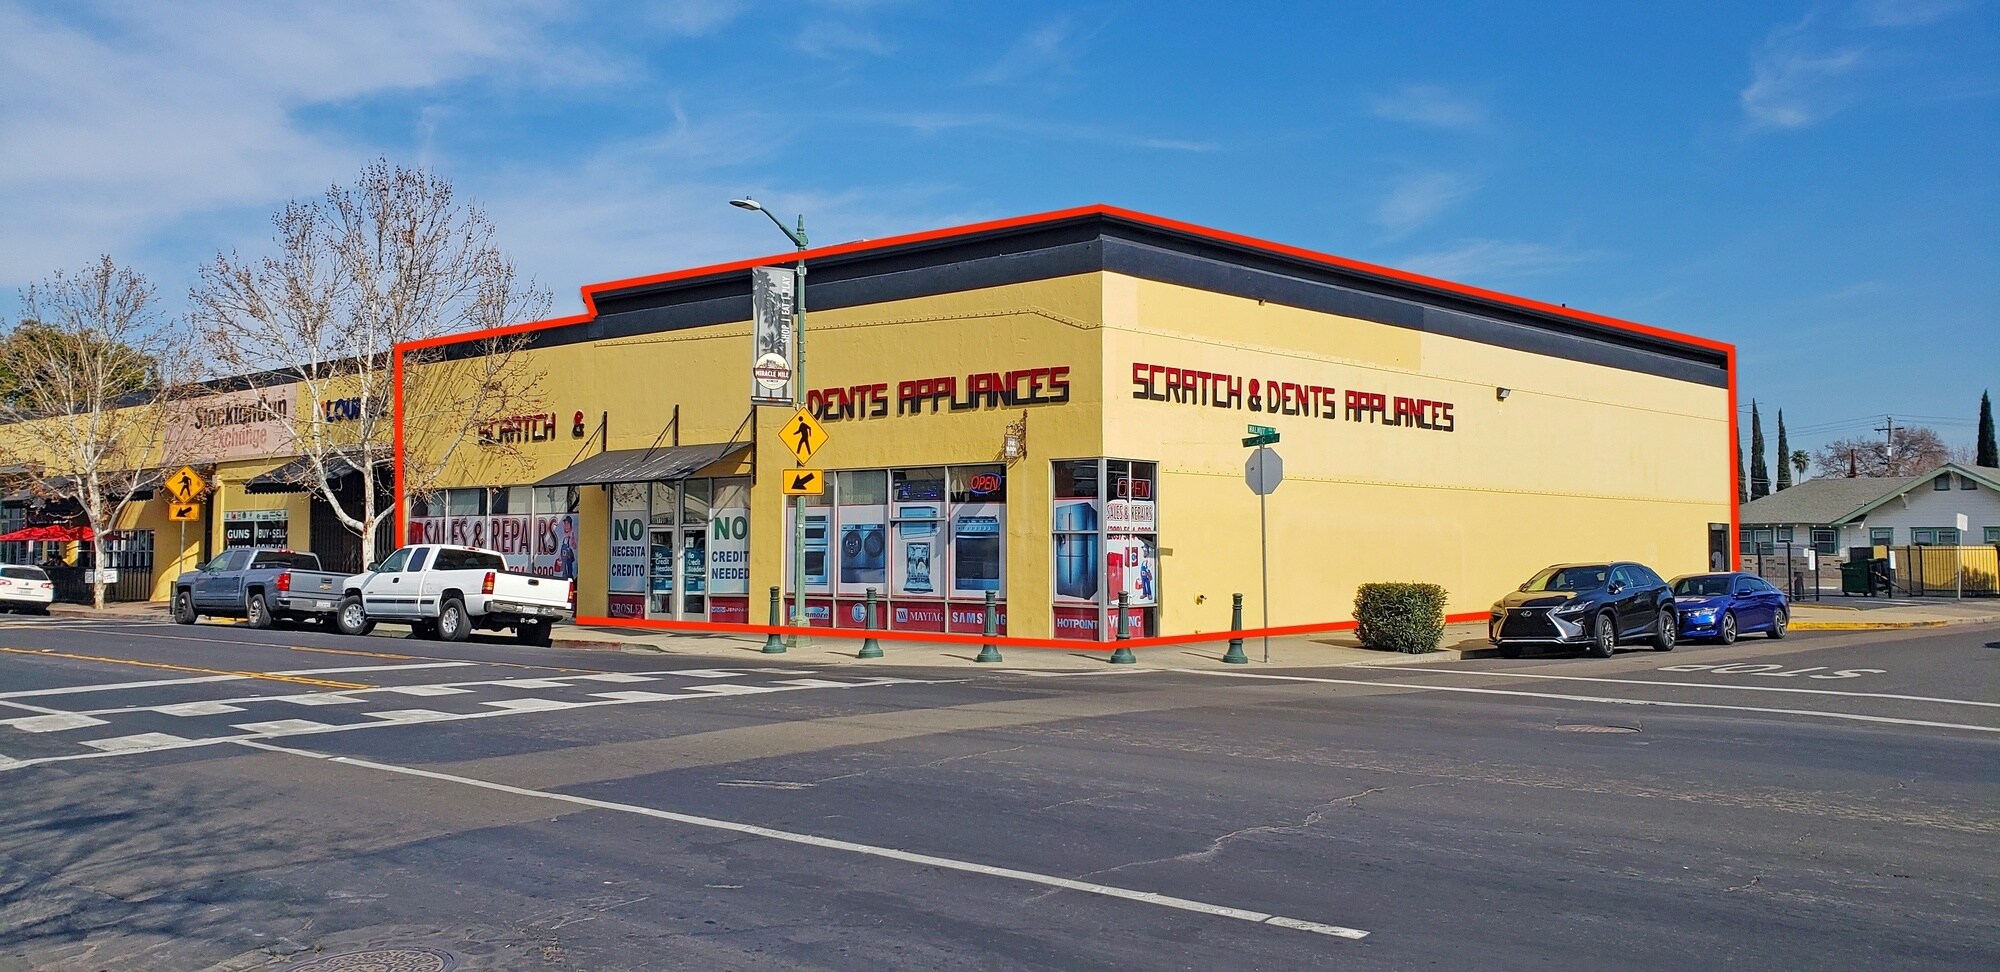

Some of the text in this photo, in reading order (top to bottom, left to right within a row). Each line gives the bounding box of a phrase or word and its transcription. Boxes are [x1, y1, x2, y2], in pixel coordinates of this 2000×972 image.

[781, 276, 791, 343] SHOP EAT PLAY
[806, 366, 1070, 423] DENTS APPLIANCES
[1133, 363, 1454, 432] SCRATCH & DENTS APPLIANCES
[572, 411, 584, 439] &
[213, 428, 267, 449] Exchange
[970, 476, 999, 491] OPEN
[1107, 504, 1123, 521] SALES
[1131, 505, 1153, 522] REPAIRS
[227, 529, 251, 539] GUNS
[474, 520, 484, 547] &
[614, 519, 644, 541] NO
[714, 516, 748, 541] NO
[612, 546, 646, 557] NECESITA
[712, 551, 750, 562] CREDIT
[611, 564, 645, 576] CREDITO
[711, 568, 750, 579] NEEDED
[611, 604, 645, 615] CROSLEY
[909, 611, 943, 621] MAYTAG
[952, 611, 1006, 625] SAMSNG
[1057, 617, 1098, 630] HOTPOINT
[1108, 615, 1141, 628] VING
